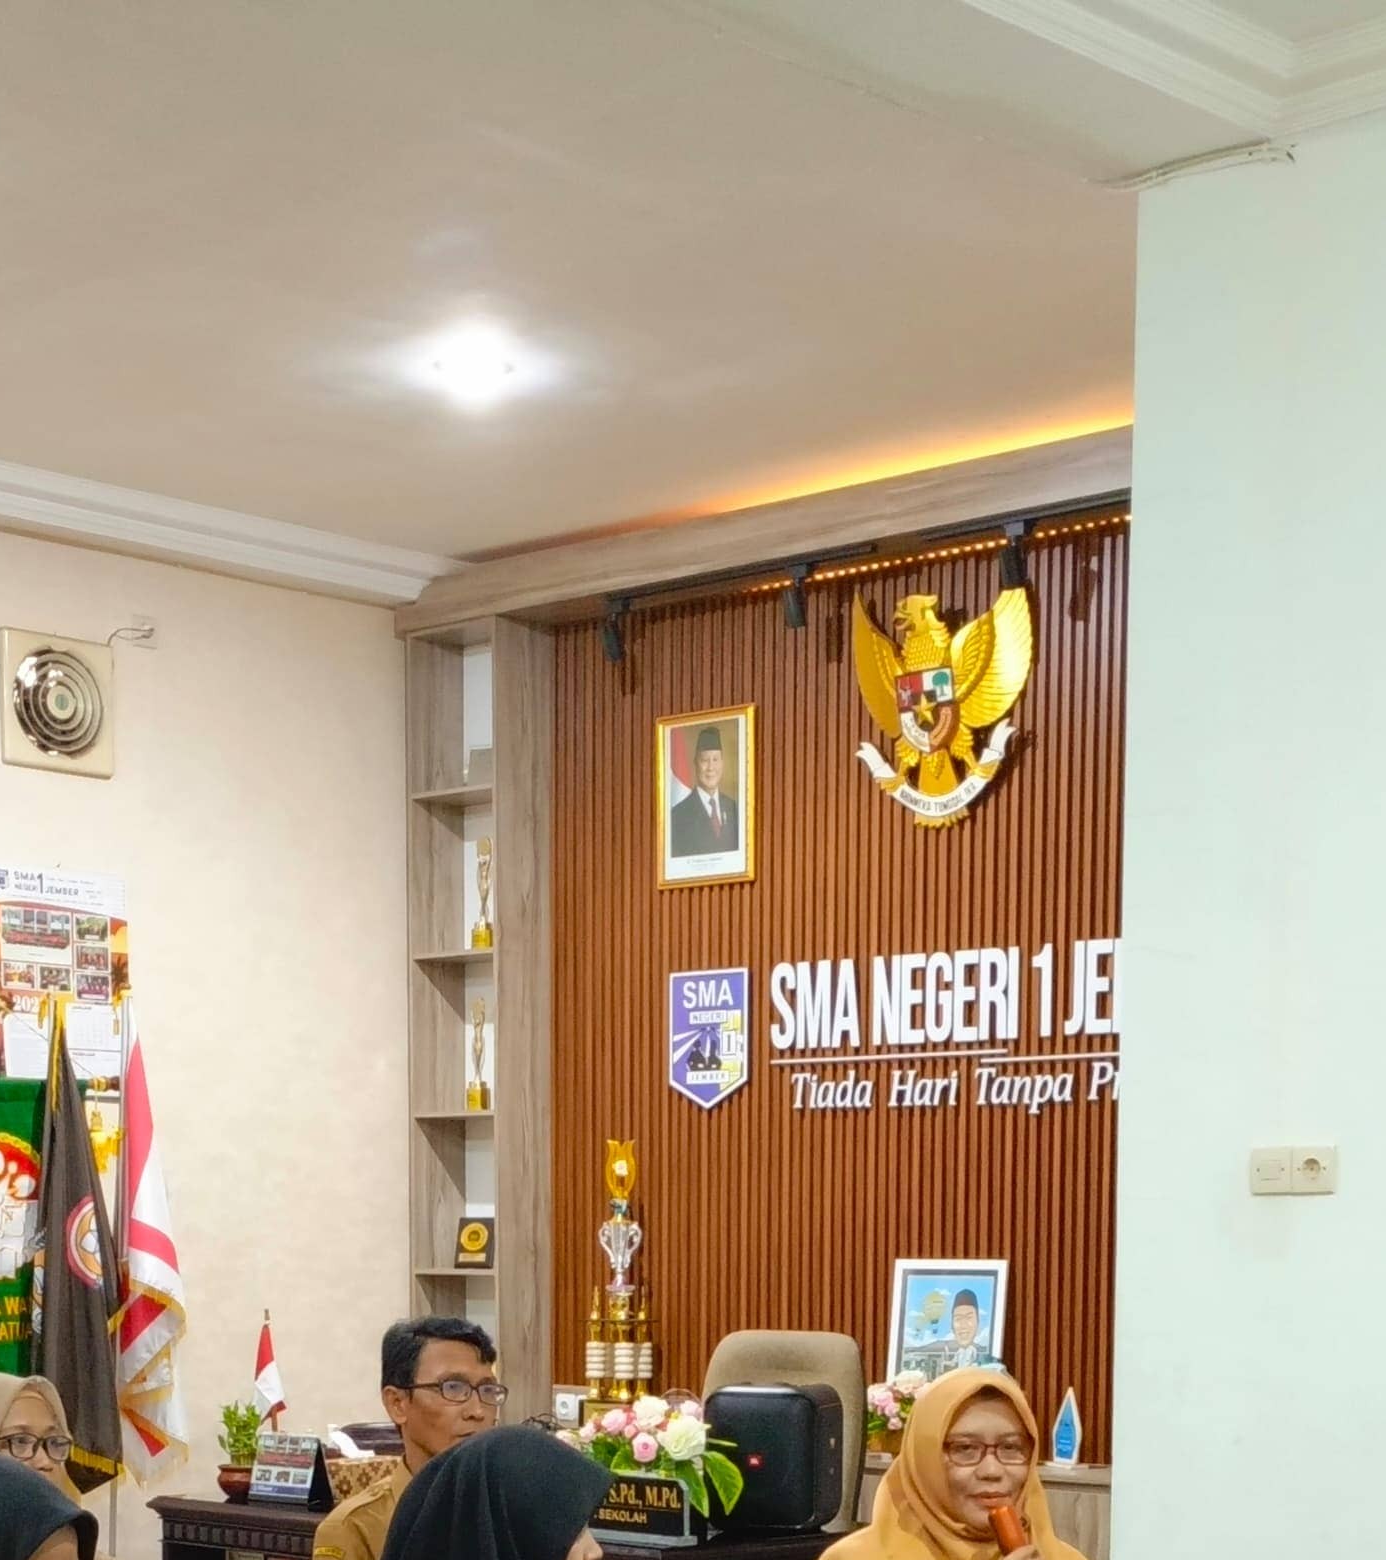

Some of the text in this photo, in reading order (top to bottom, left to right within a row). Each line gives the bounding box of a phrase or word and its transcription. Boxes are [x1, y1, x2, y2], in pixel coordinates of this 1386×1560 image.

[45, 886, 79, 896] JEMBER
[14, 996, 39, 1013] 202
[682, 979, 734, 1009] SMA
[770, 958, 860, 1049] SMA
[872, 946, 1020, 1046] NEGERI
[1031, 942, 1053, 1038] 1
[791, 1069, 873, 1110] Tiada
[888, 1068, 959, 1108] Hari
[975, 1067, 1074, 1114] Tanpa
[4, 1296, 28, 1315] WA
[645, 1485, 682, 1509] M.Pd.
[598, 1508, 648, 1524] SEKOLAH
